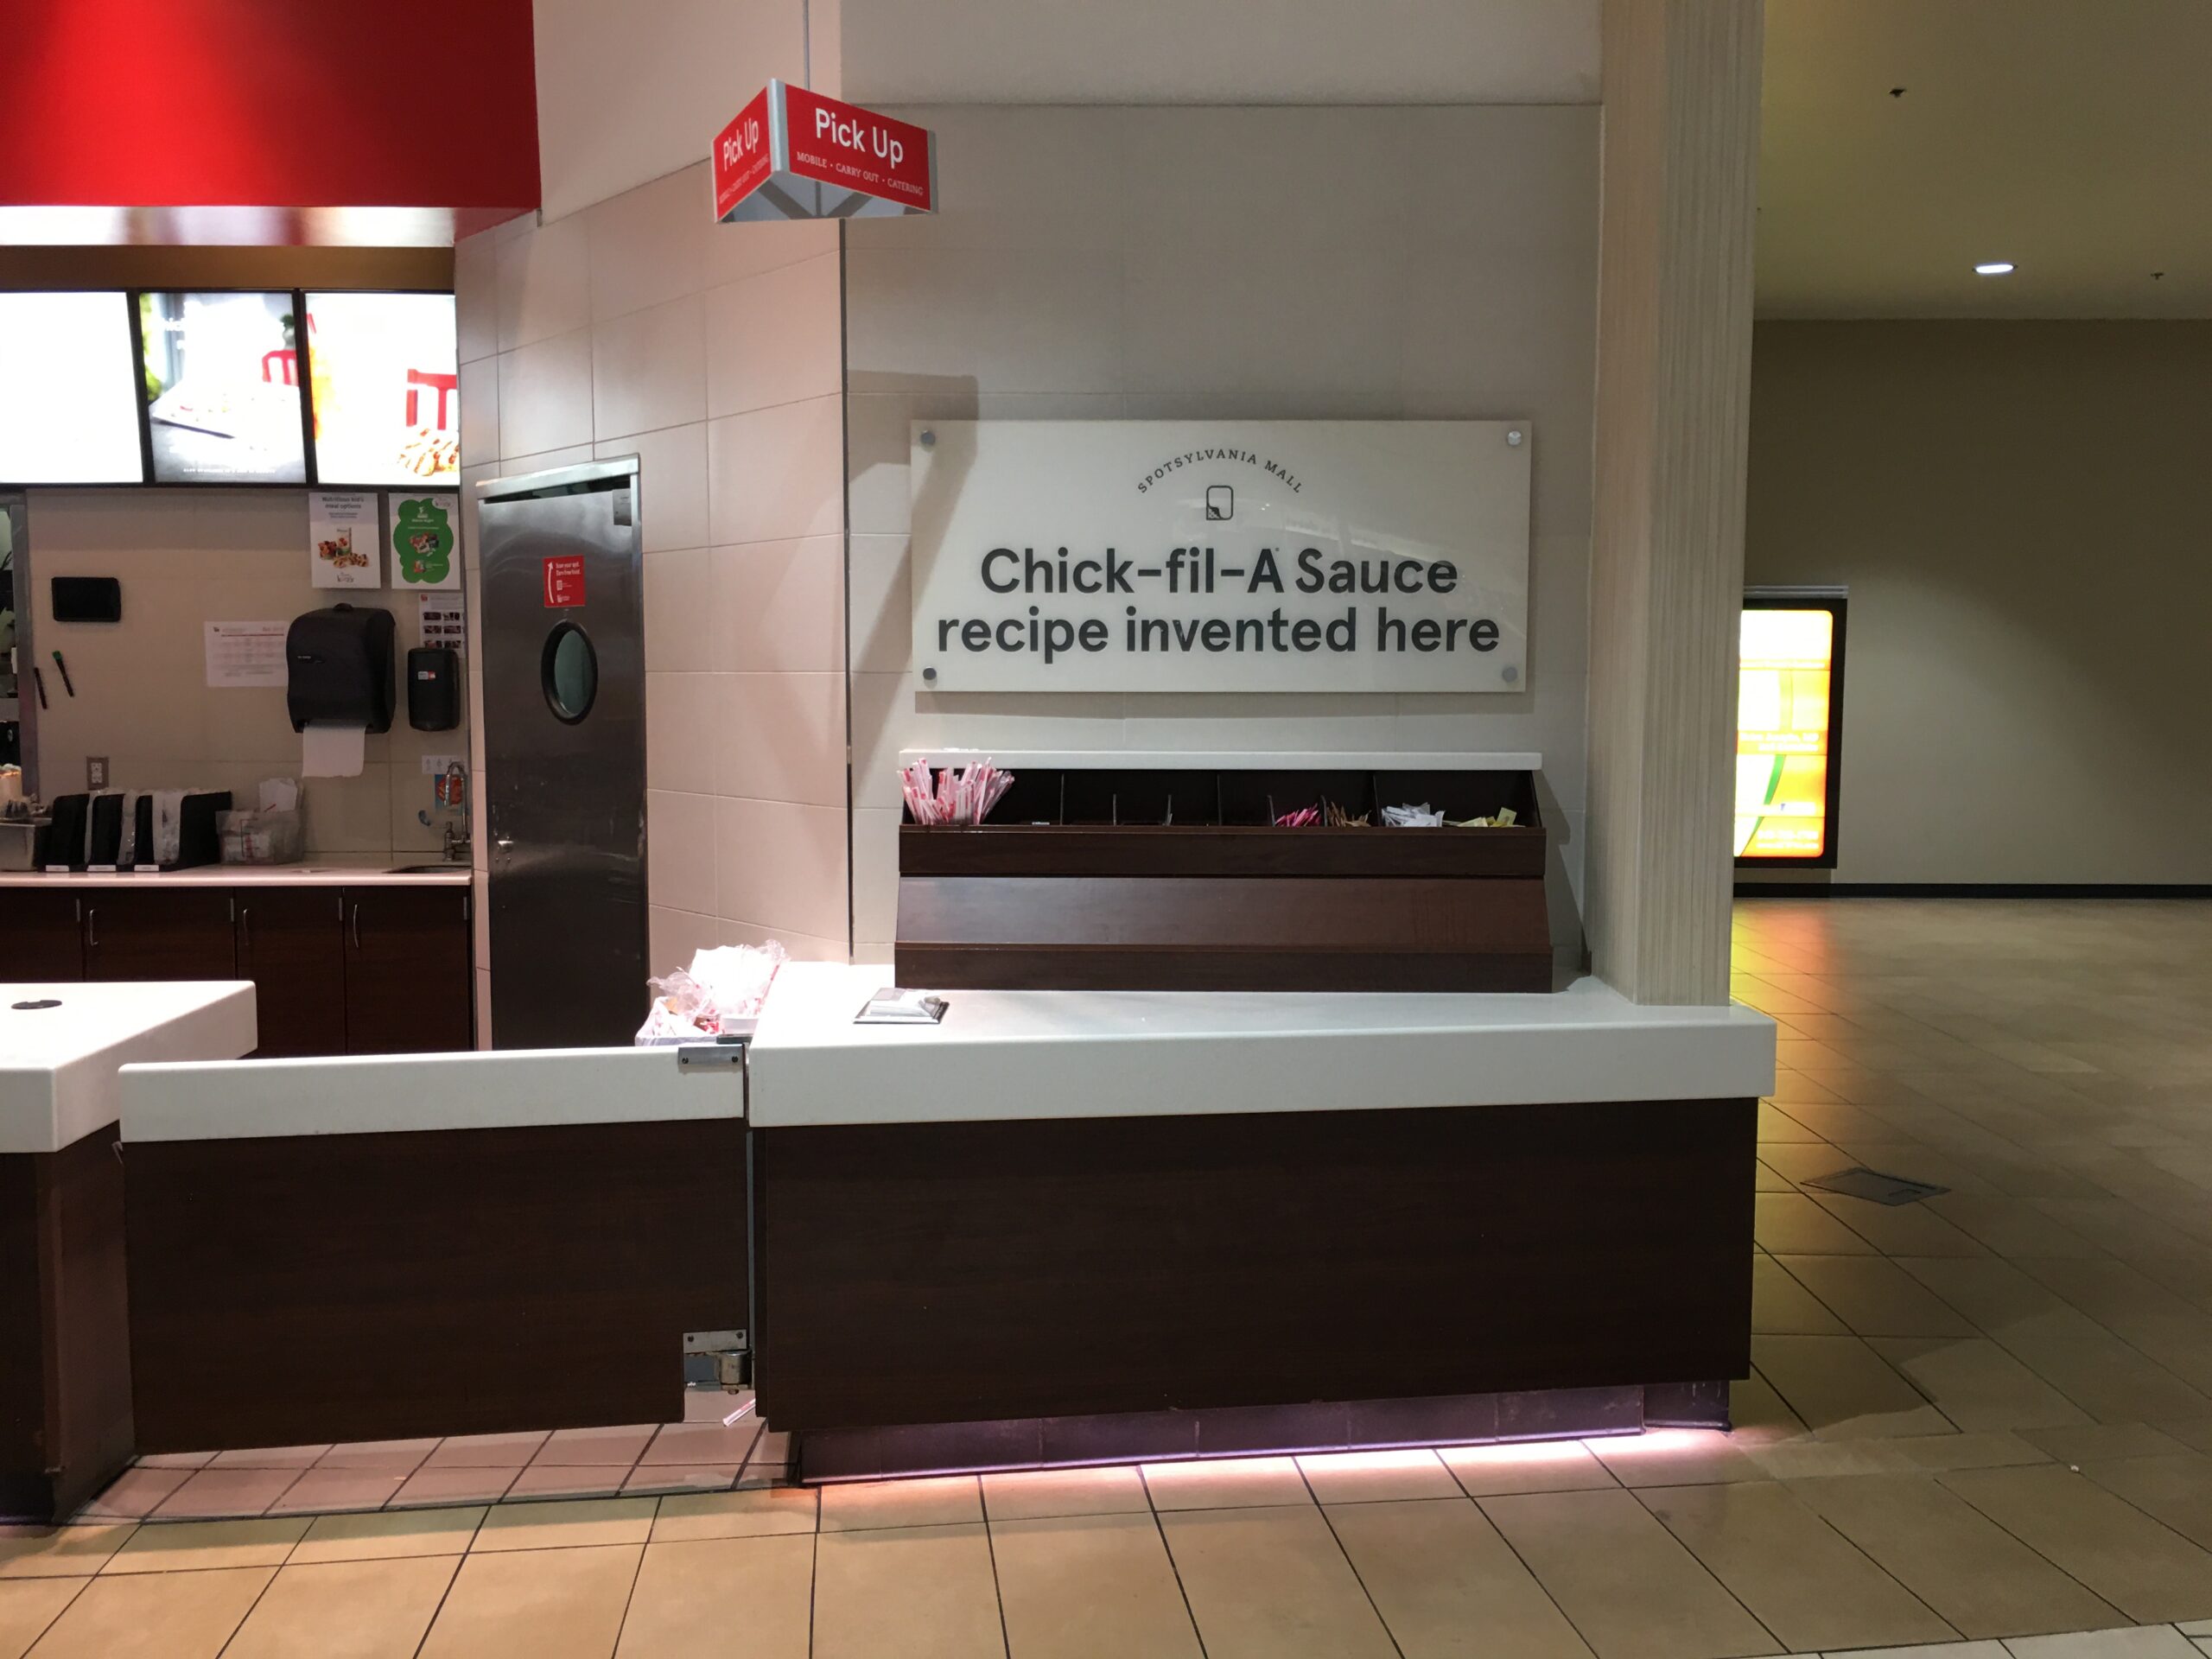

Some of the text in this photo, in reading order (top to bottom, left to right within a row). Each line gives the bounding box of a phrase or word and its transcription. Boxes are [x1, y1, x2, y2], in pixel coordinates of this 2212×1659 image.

[722, 118, 760, 171] Pick Up
[815, 107, 905, 170] Pick Up
[796, 151, 924, 195] MOBILE CARRY OUT CATERING
[1137, 448, 1303, 493] SPOTSYLVANIA MALL
[981, 546, 1459, 594] Chick-fil-A Sauce
[938, 605, 1500, 664] recipe invented here
